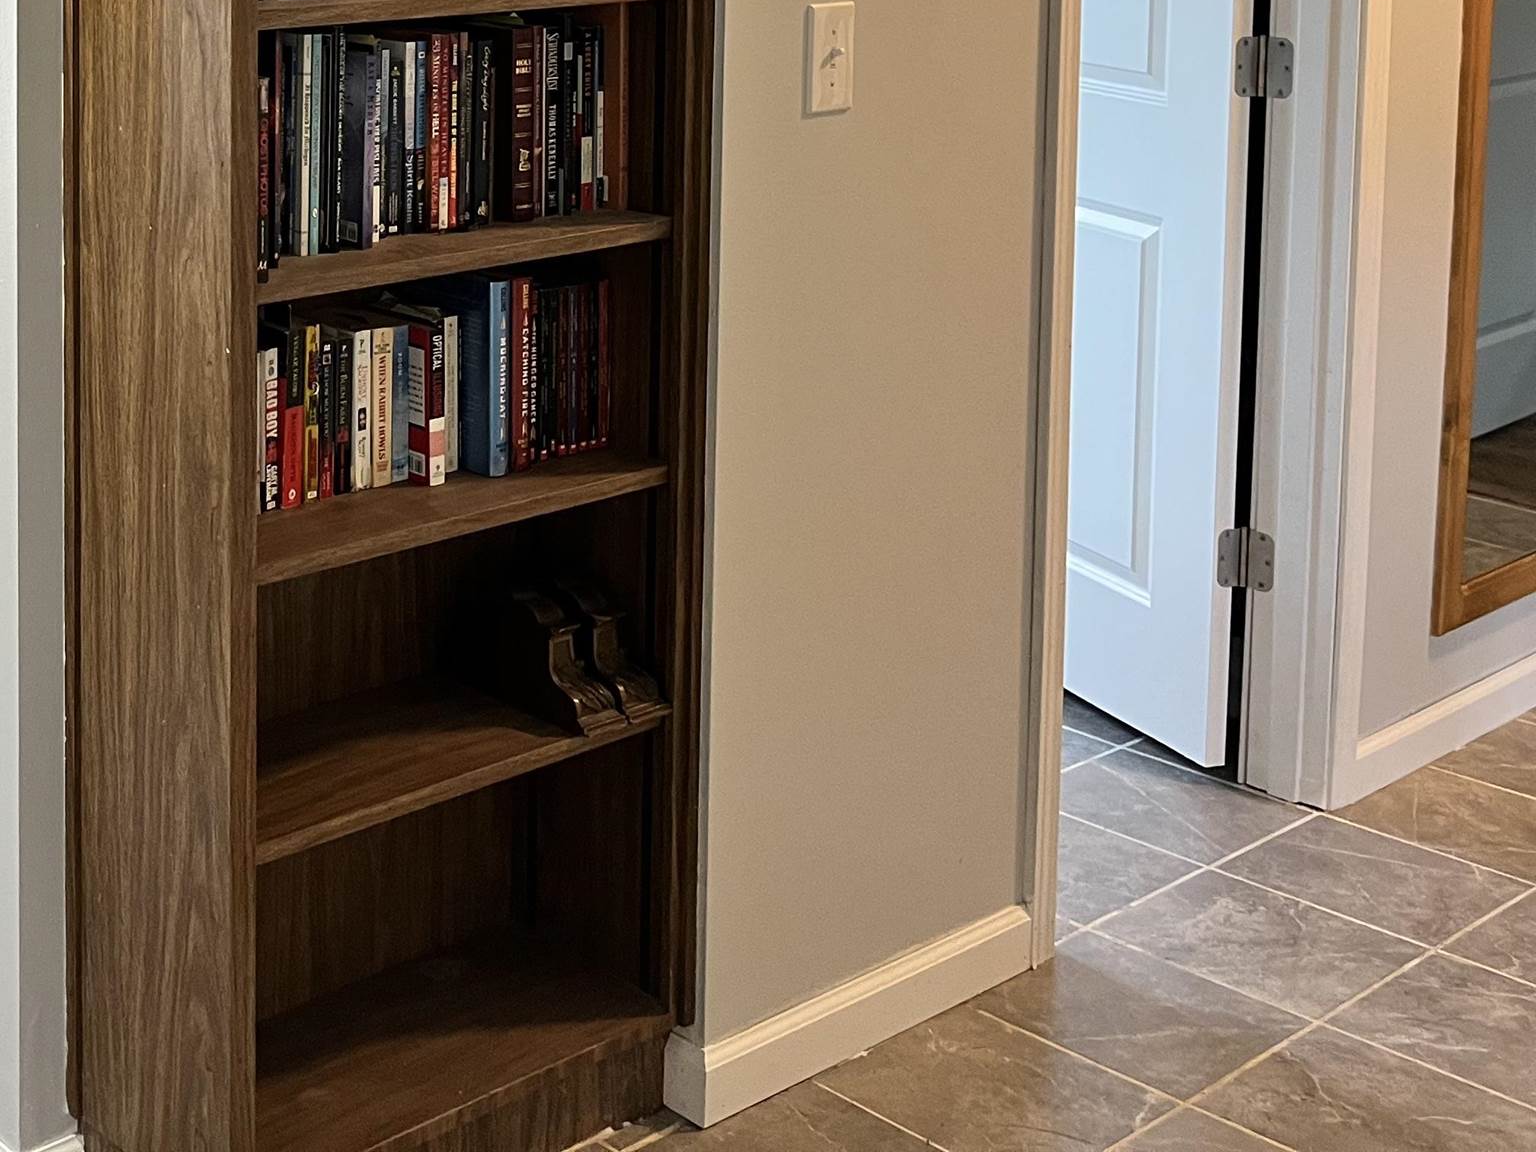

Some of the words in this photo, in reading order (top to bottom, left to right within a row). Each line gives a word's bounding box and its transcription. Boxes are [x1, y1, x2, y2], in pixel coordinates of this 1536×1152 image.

[432, 56, 440, 100] MINUTES
[432, 114, 440, 138] HELL
[442, 116, 448, 128] IN
[548, 104, 556, 138] THOMAS
[260, 118, 268, 162] GHOST
[405, 154, 414, 188] Spirit
[548, 138, 556, 180] KENEALLY
[260, 164, 268, 216] PHOTOS
[406, 190, 414, 224] Realm
[432, 334, 442, 371] OPTICAL
[378, 356, 386, 385] WHEN
[266, 380, 278, 410] BAD
[378, 388, 386, 423] RABBIT
[432, 372, 441, 416] ILLUSIONS
[266, 411, 278, 438] BOY
[378, 426, 386, 460] HOWLS
